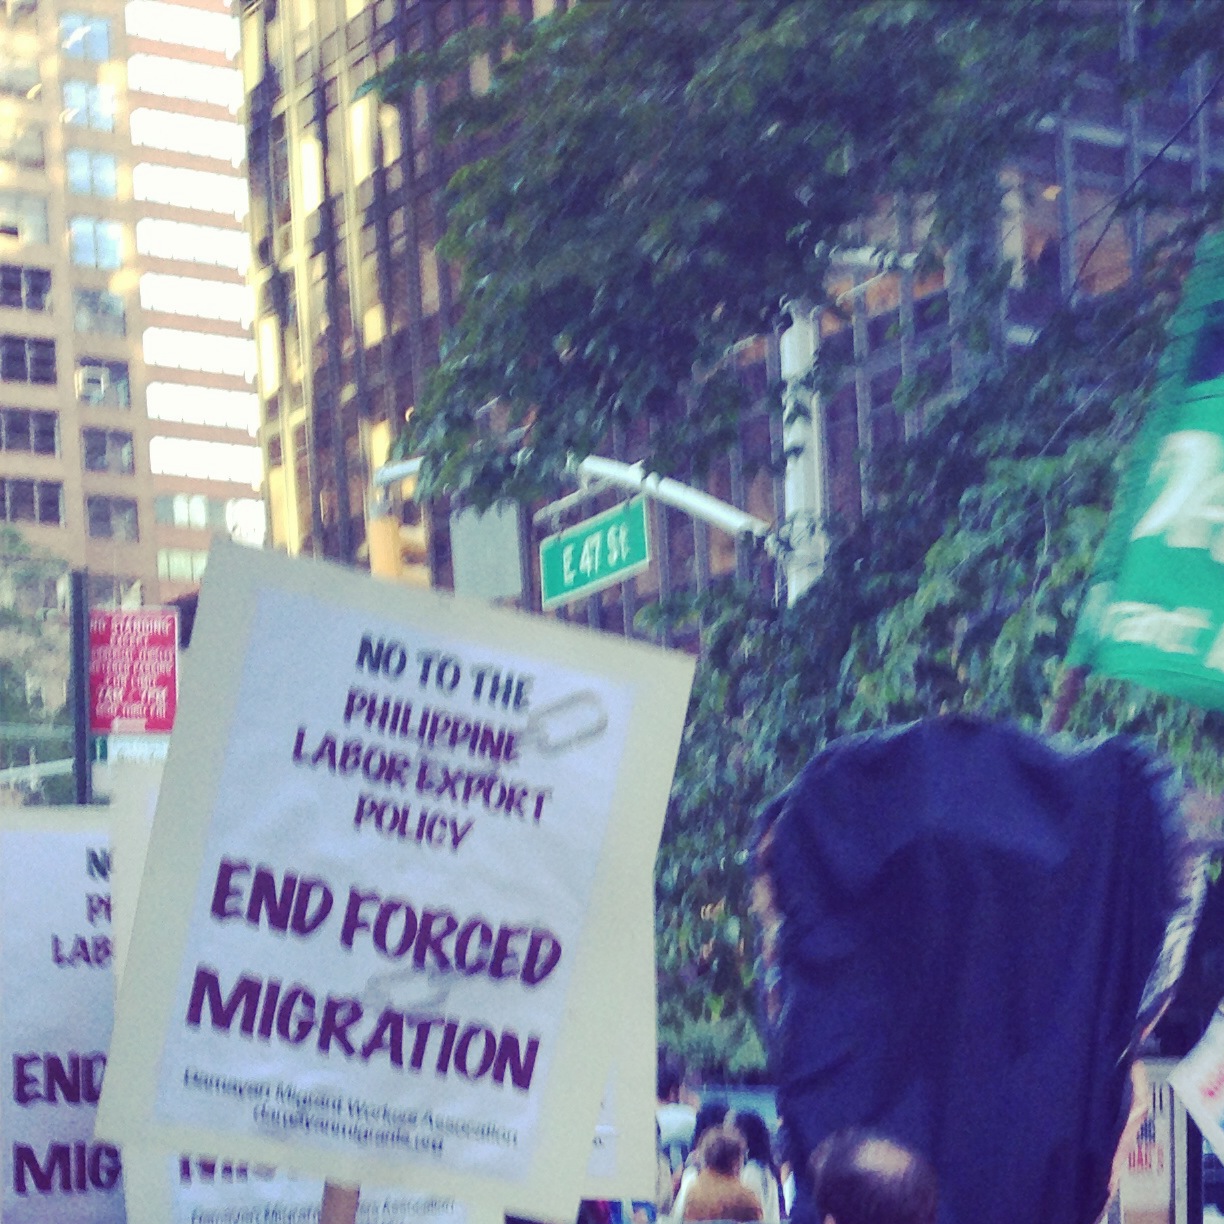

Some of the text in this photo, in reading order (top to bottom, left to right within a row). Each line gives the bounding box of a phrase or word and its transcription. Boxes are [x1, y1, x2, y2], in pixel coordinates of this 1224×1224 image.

[355, 630, 534, 712] NO TO THE
[343, 685, 522, 766] PHILIPPINE
[292, 723, 552, 825] LABOR EXPORT
[354, 791, 475, 854] POLICY
[210, 853, 562, 988] END FORCED
[185, 961, 540, 1093] MIGRATION
[12, 1140, 122, 1197] MIG
